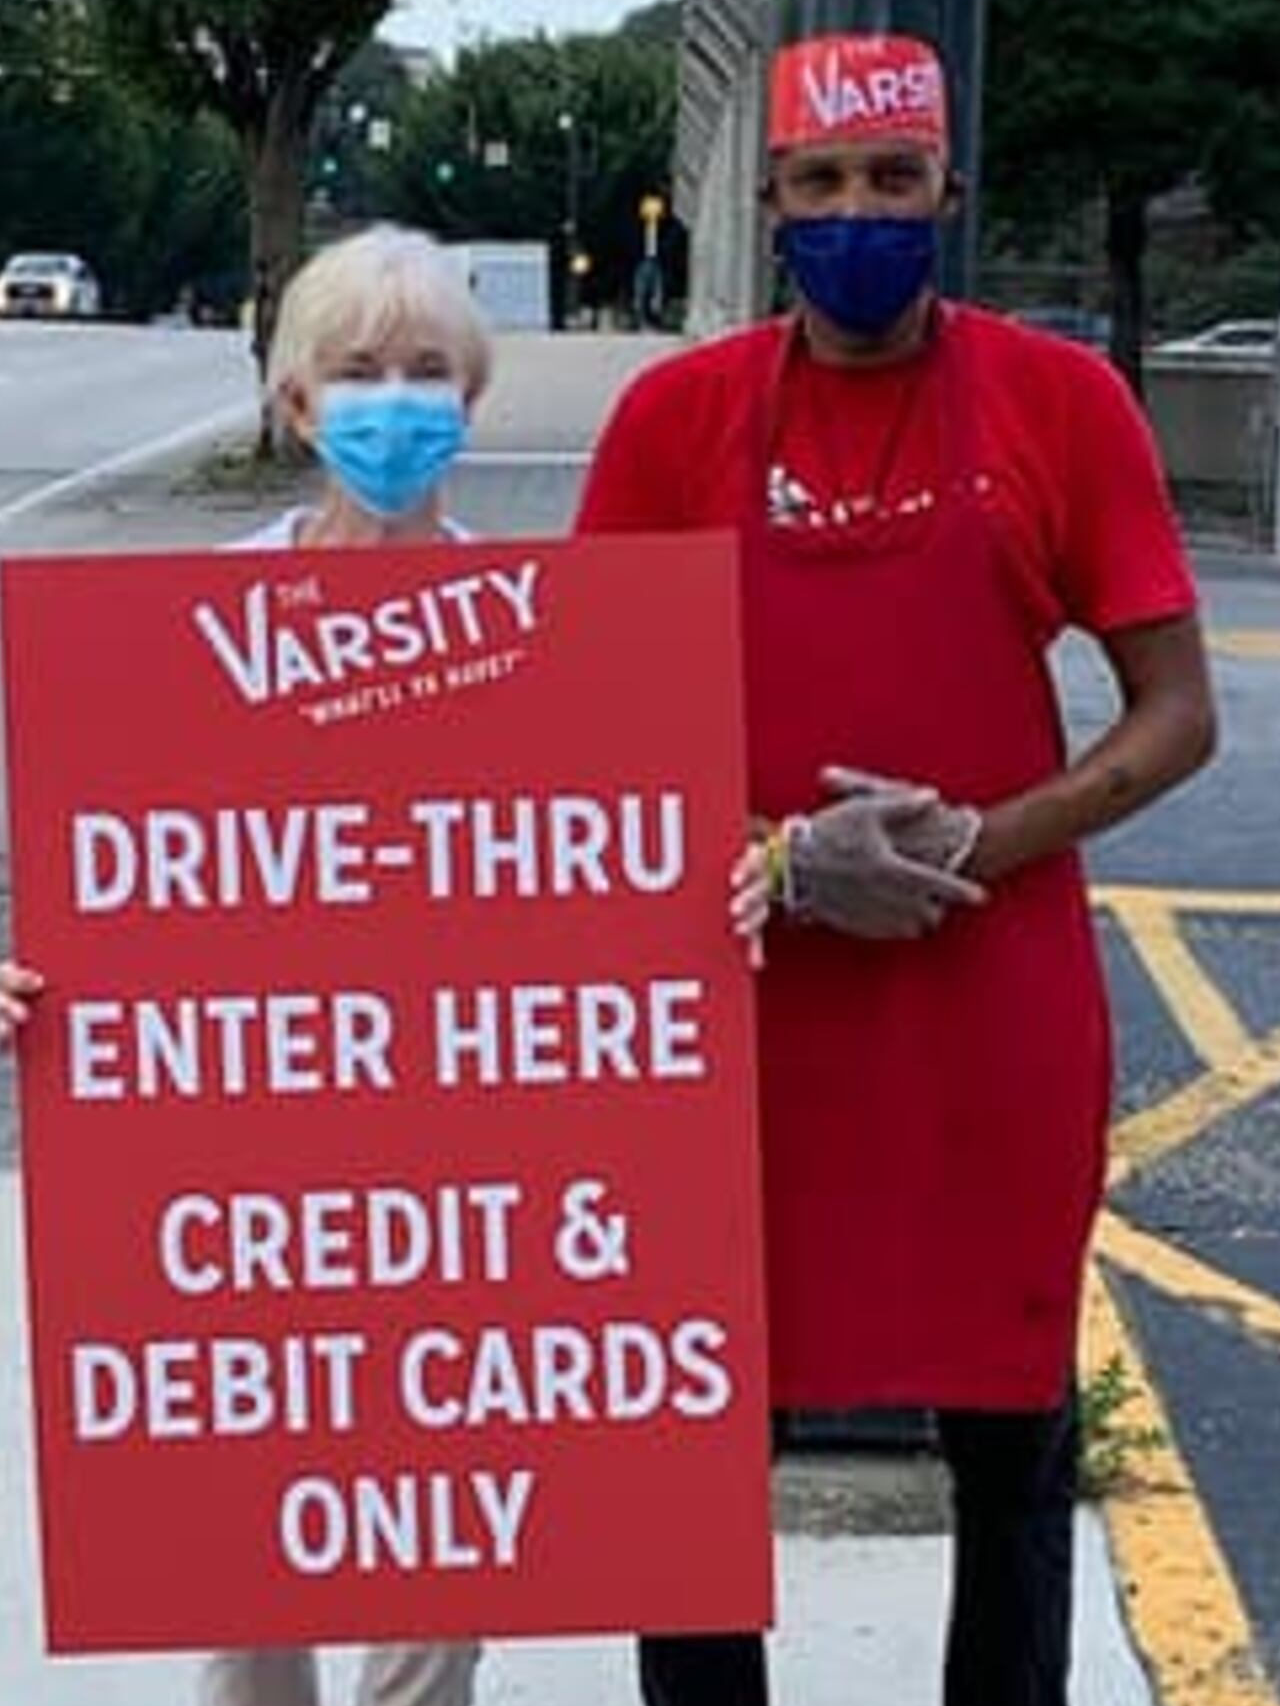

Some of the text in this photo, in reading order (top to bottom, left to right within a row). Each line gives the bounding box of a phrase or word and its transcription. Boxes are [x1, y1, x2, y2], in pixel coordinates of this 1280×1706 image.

[194, 561, 538, 704] VARSITY
[72, 793, 684, 912] DRIVE-THRU
[68, 979, 706, 1100] ENTER HERE
[159, 1179, 629, 1294] CREDIT &
[72, 1319, 732, 1440] DEBIT CARDS
[280, 1469, 534, 1574] ONLY
